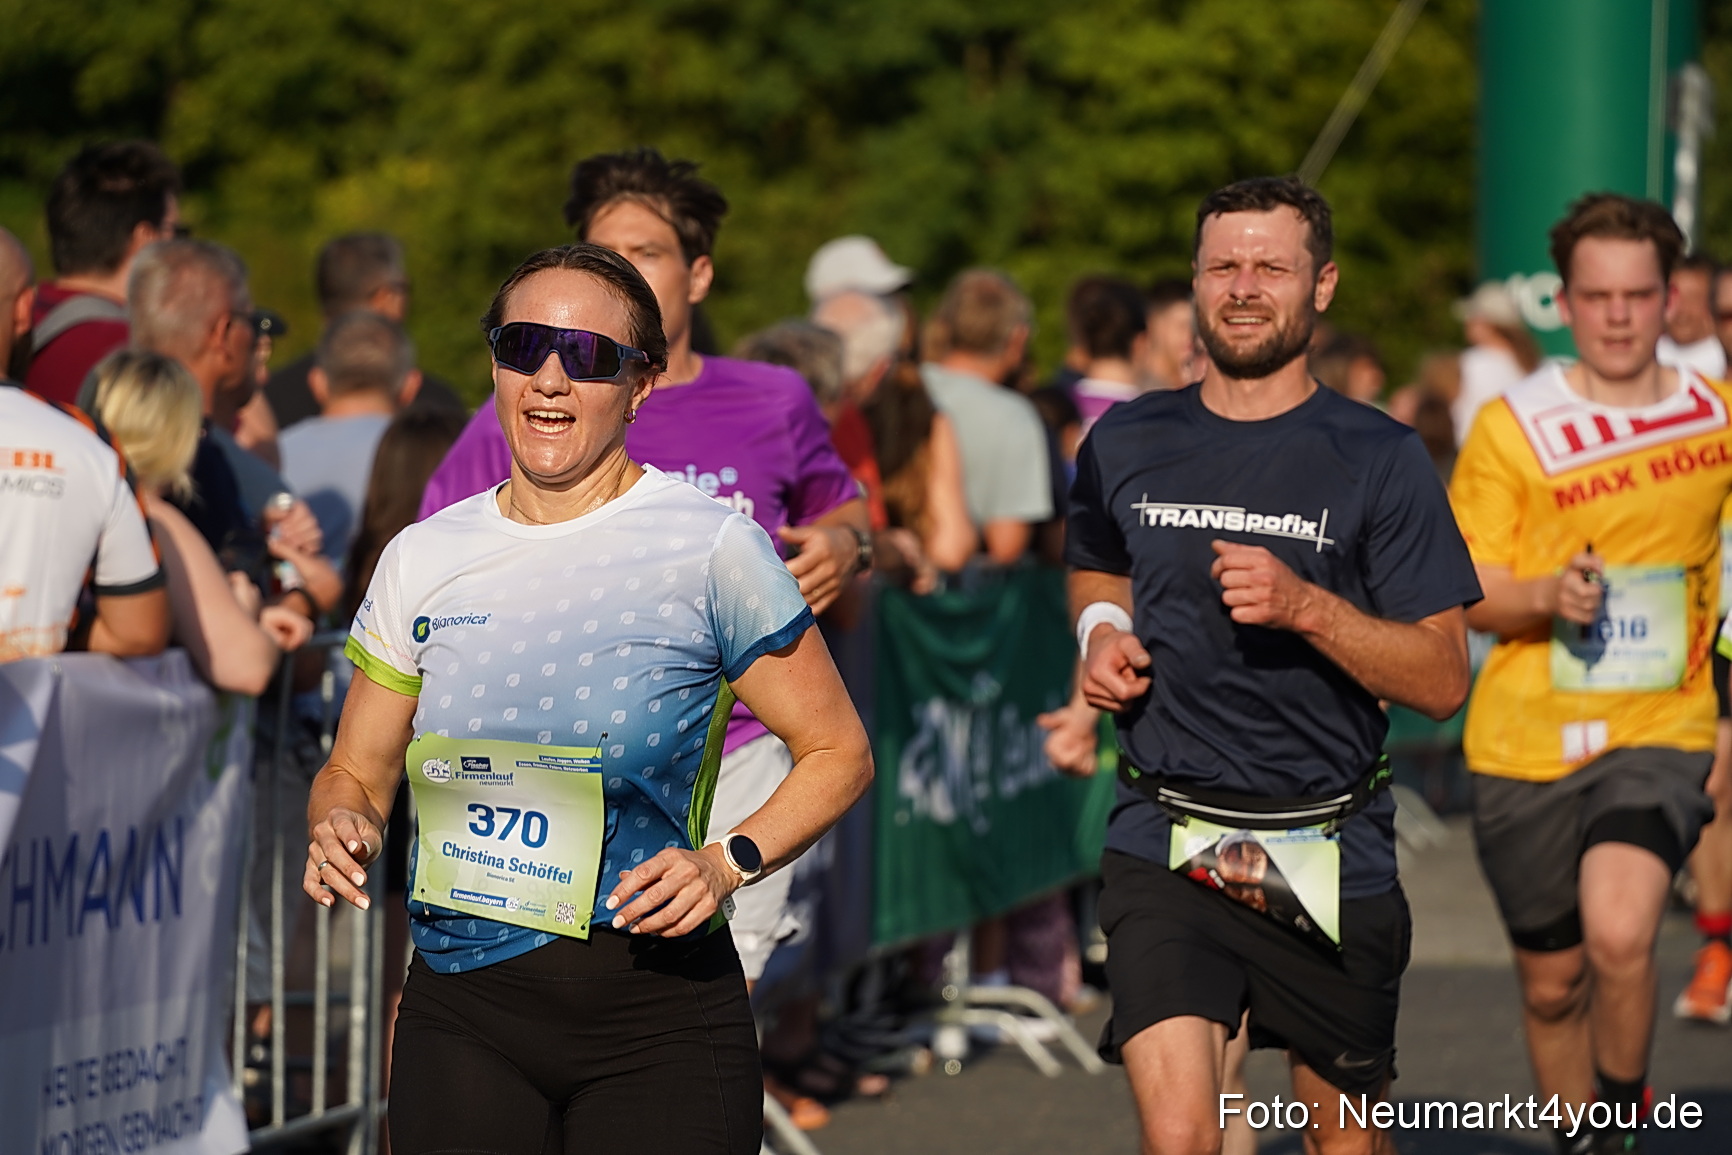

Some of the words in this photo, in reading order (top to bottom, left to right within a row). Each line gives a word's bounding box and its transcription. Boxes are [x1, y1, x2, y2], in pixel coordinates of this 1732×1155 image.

[1554, 465, 1637, 510] MAX
[1145, 507, 1318, 537] TRANSpofix
[455, 771, 514, 781] Firmenlauf
[467, 803, 549, 848] 370
[442, 842, 505, 870] Christina
[508, 857, 573, 885] Schöffel
[452, 891, 504, 907] firmenlauf.bayern
